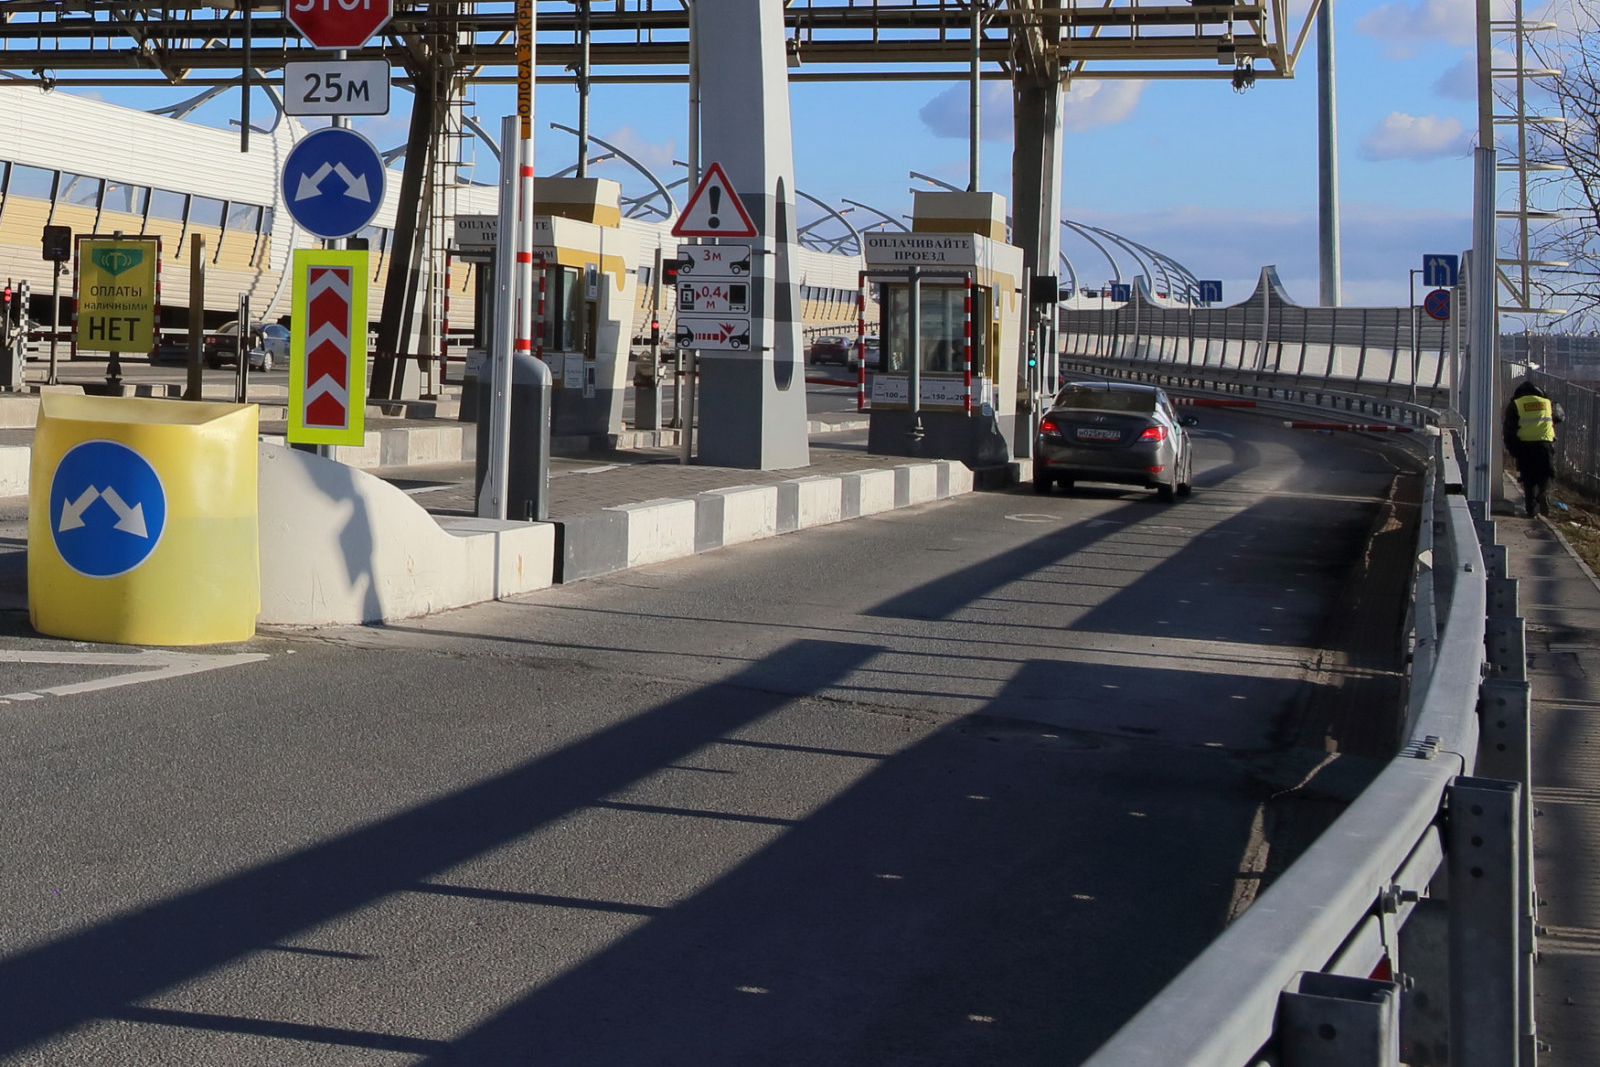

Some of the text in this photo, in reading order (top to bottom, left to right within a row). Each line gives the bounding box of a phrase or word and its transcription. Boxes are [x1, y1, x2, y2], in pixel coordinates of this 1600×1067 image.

[869, 237, 970, 249] ОПЛАЧИВАЙТЕ
[894, 251, 946, 262] ПРОЕЗД
[90, 285, 142, 297] ОПЛАТЫ
[84, 301, 148, 311] наличными
[89, 316, 141, 342] НЕТ
